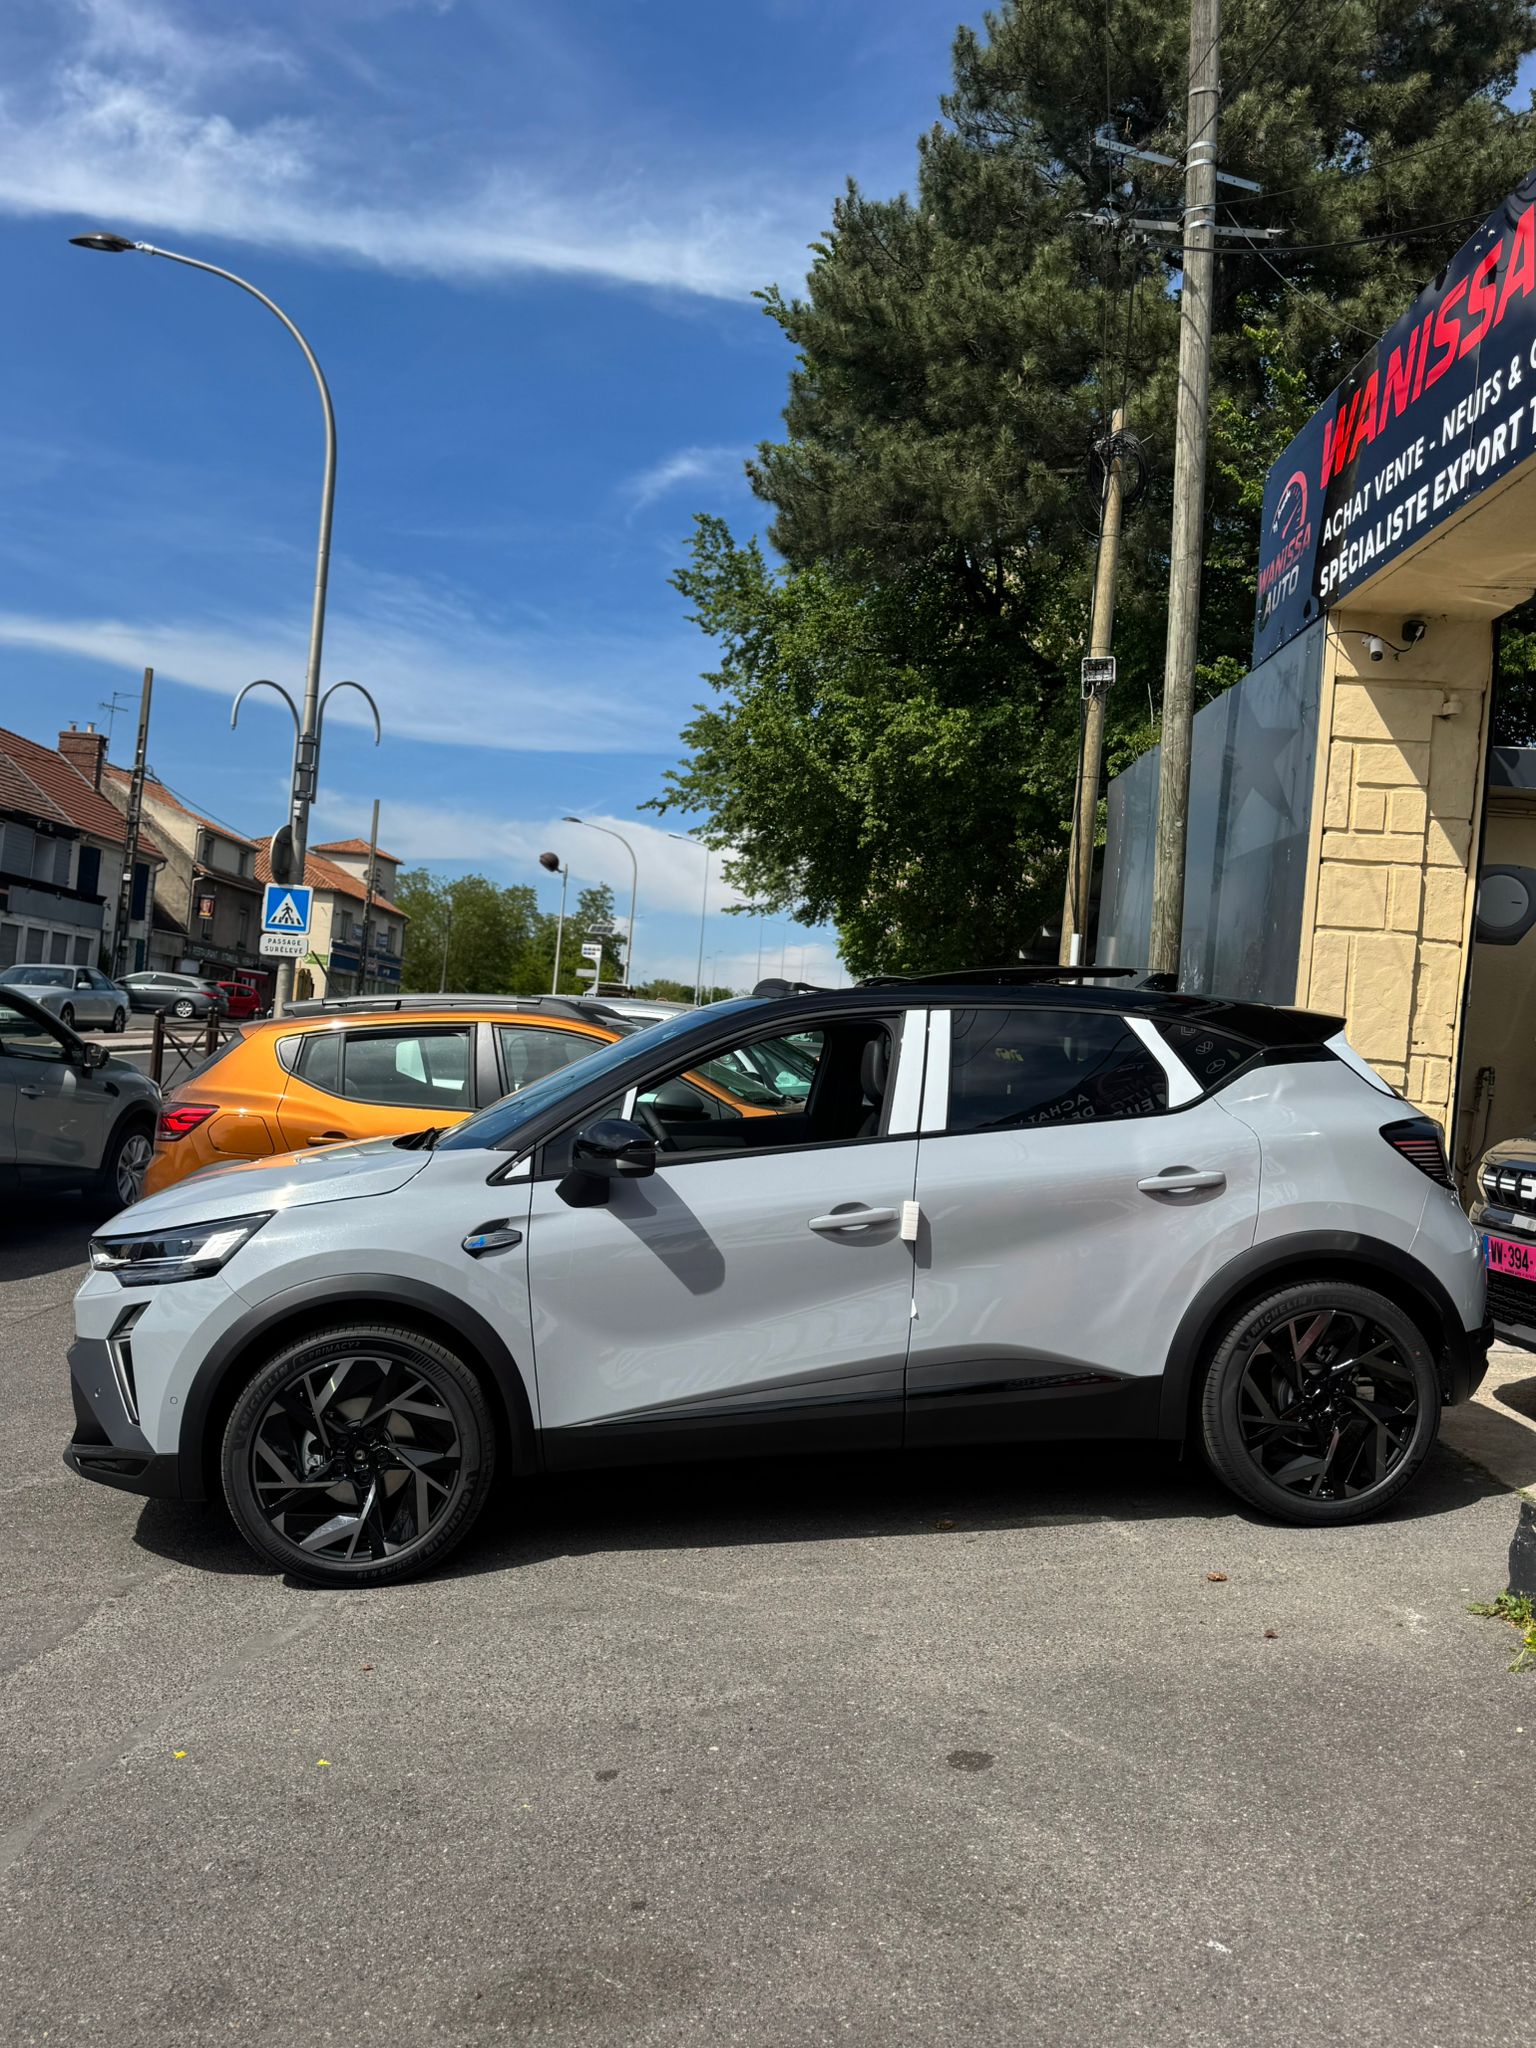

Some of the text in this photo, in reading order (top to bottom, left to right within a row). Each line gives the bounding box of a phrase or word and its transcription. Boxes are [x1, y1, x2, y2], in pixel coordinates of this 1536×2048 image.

[1320, 204, 1534, 489] WANISSA
[1323, 482, 1371, 546] ACHAT
[1375, 436, 1425, 501] VENTE
[1442, 369, 1502, 447] NEUFS
[1508, 355, 1521, 390] &
[1320, 406, 1524, 598] SPÉCIALISTE EXPORT
[1258, 522, 1311, 598] WANISSA
[1263, 564, 1299, 620] AUTO
[268, 938, 301, 946] PASSAGE
[1250, 1294, 1308, 1336] MICHELIN
